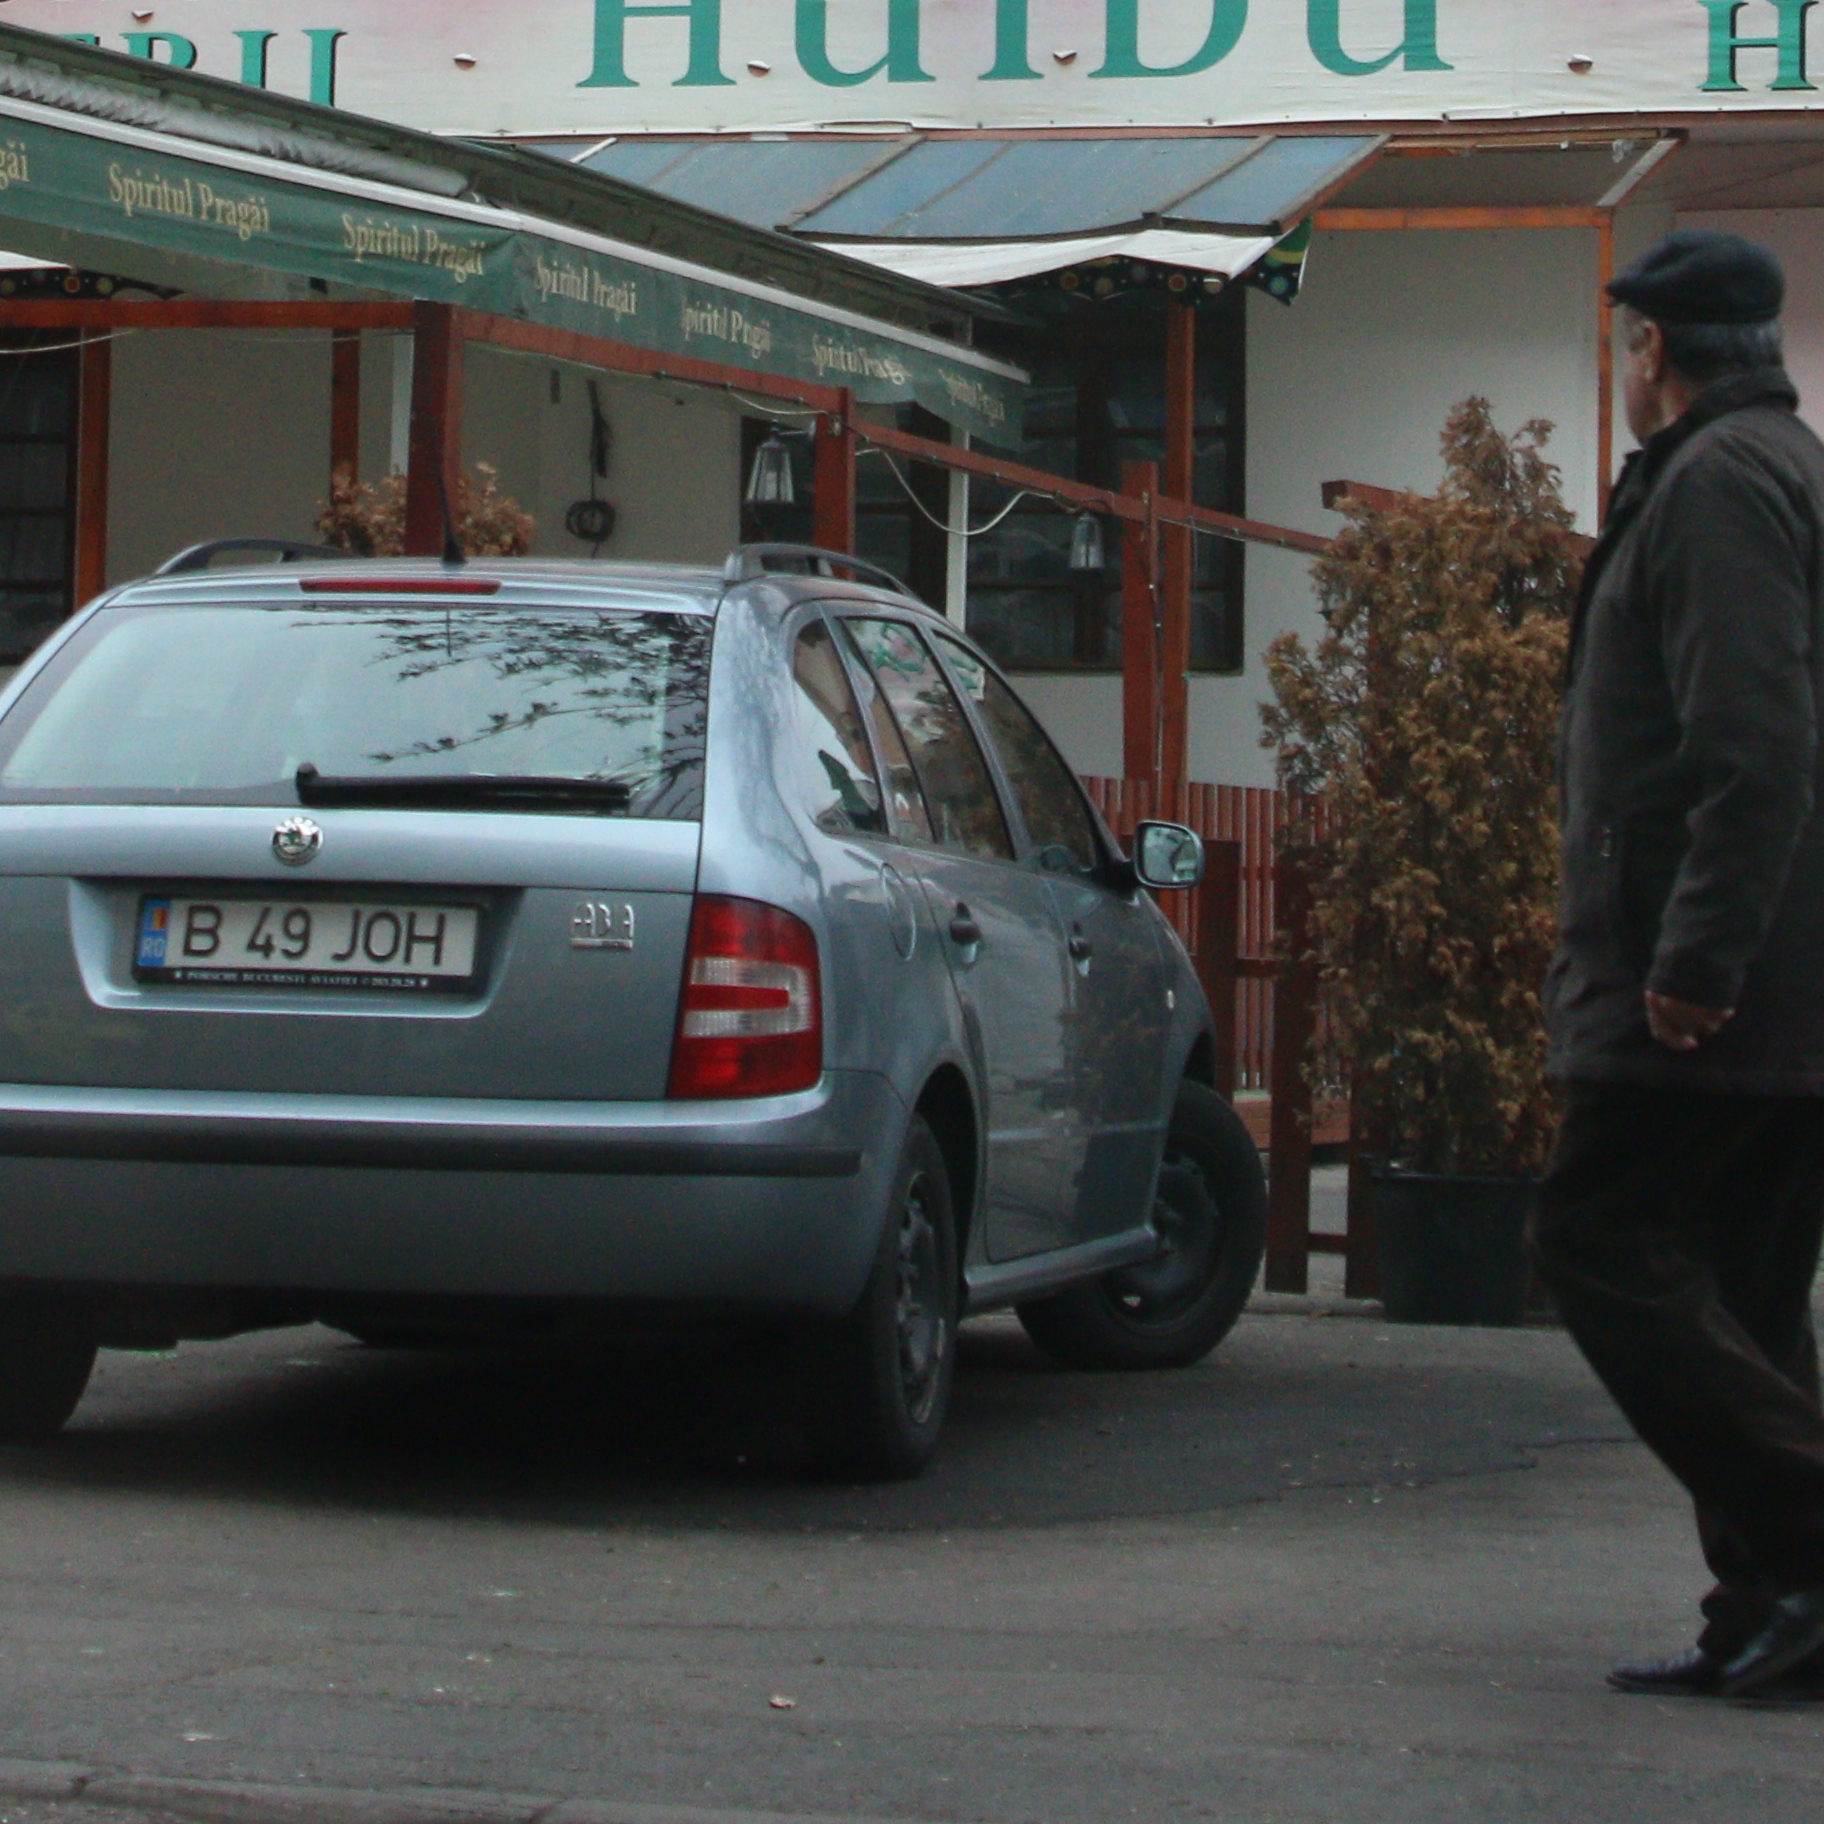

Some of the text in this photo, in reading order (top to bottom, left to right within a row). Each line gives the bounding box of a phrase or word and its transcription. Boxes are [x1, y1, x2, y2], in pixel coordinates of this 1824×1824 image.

[108, 162, 271, 241] Spiritul Pragăi
[340, 213, 420, 264] Spiritul
[183, 905, 447, 966] B 49 JOH
